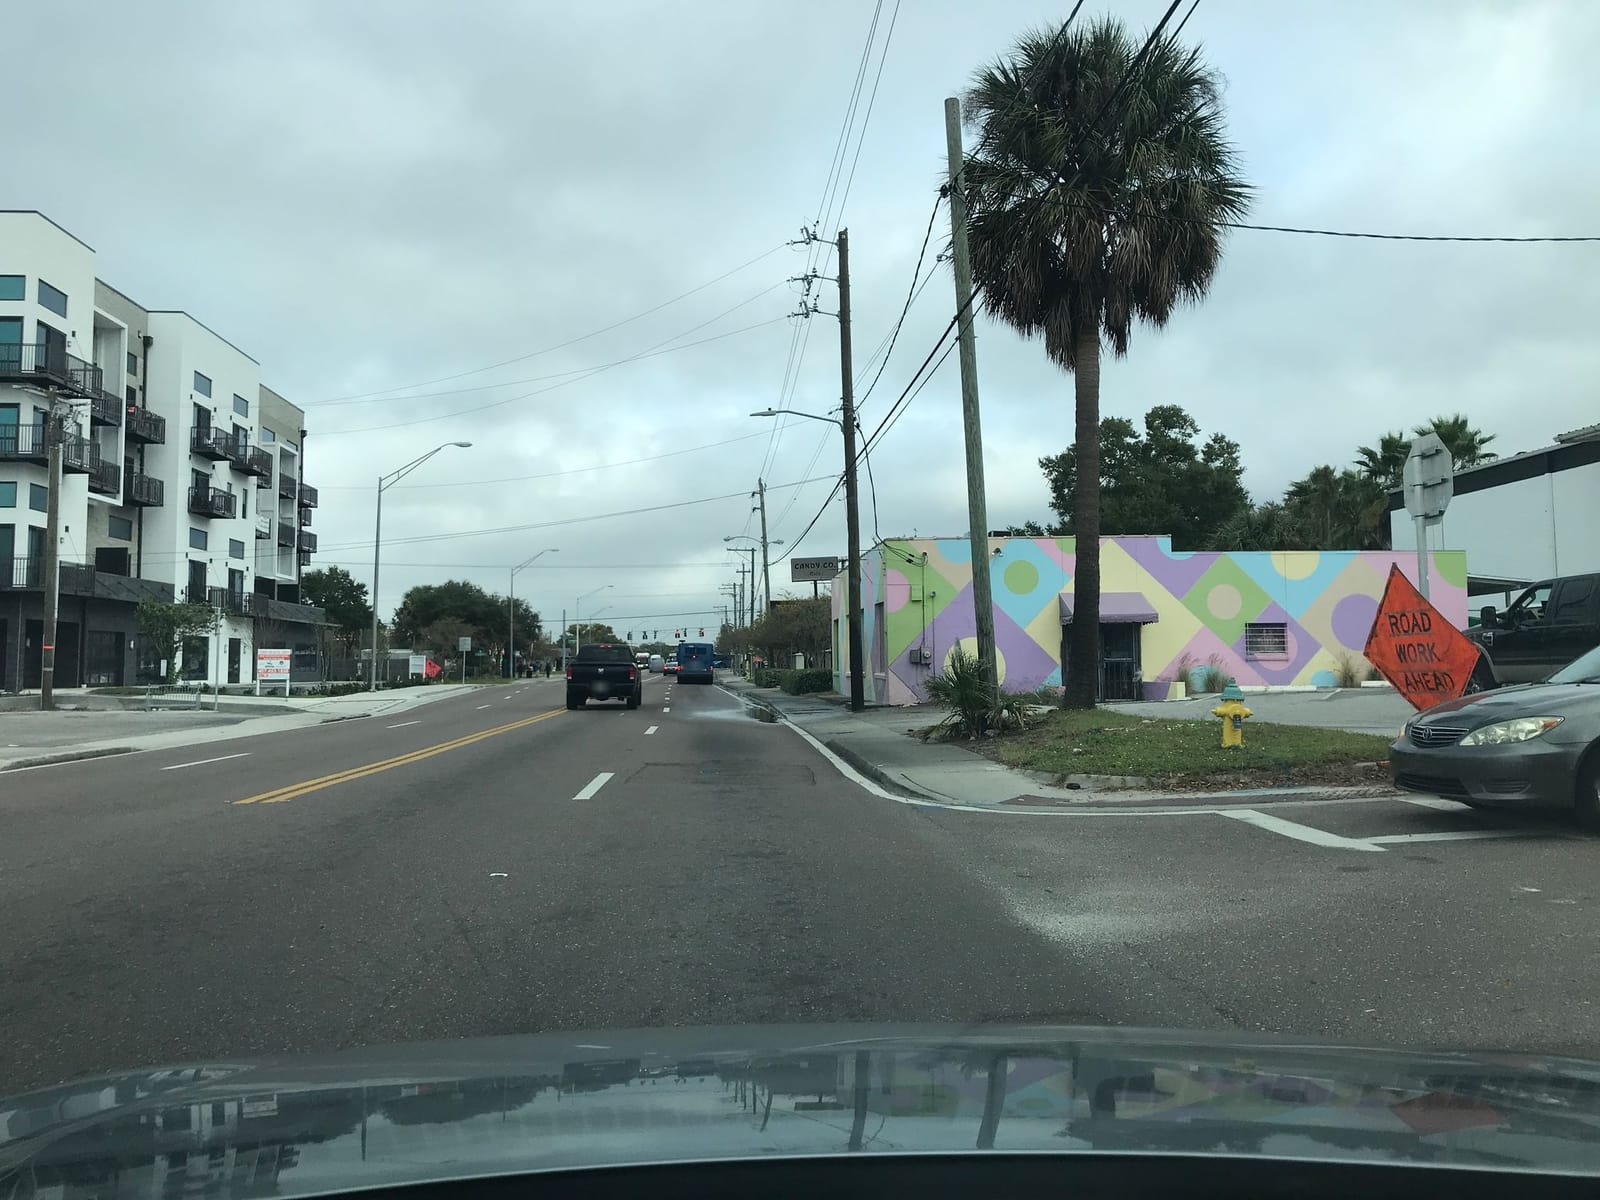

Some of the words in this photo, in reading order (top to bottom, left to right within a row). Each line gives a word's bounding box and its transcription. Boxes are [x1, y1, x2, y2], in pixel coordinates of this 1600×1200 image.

[1388, 612, 1431, 634] ROAD
[1395, 642, 1441, 663] WORK
[1404, 670, 1455, 692] AHEAD
